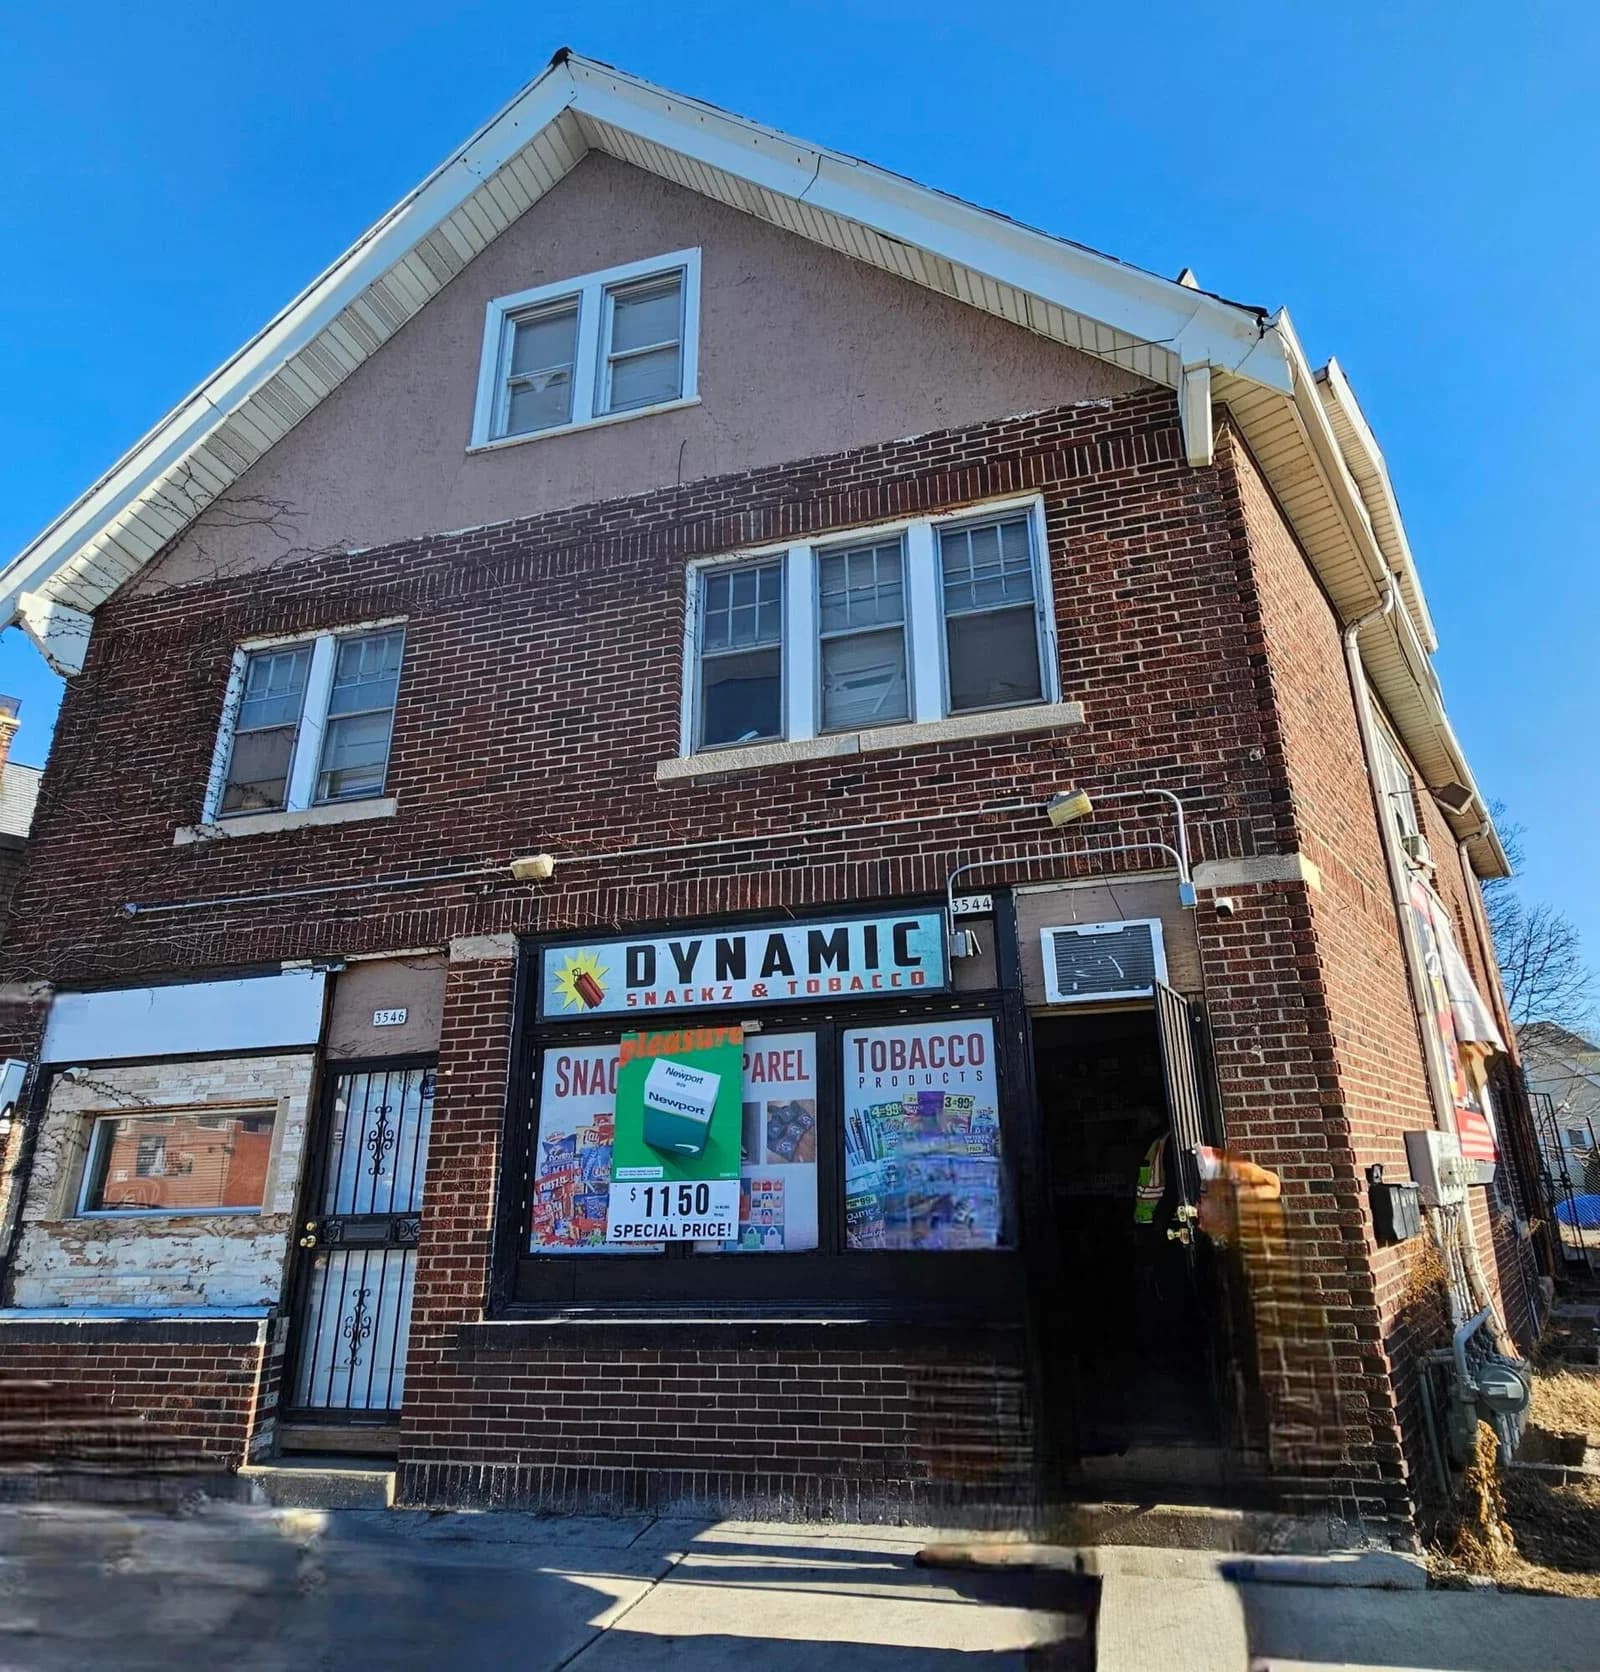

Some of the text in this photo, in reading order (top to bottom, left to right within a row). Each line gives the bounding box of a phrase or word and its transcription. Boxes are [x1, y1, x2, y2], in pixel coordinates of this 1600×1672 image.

[951, 898, 992, 913] 3544
[625, 921, 922, 989] DYNAMIC
[626, 970, 925, 1007] SNACKZ & TOBACCO
[375, 1010, 405, 1024] 3546
[619, 1026, 743, 1069] pleasure
[853, 1033, 985, 1073] TOBACCO
[665, 1066, 704, 1085] Newport
[859, 1070, 983, 1088] PRODUCTS
[648, 1091, 706, 1116] Newport
[613, 1222, 732, 1238] SPECIAL PRICE!
